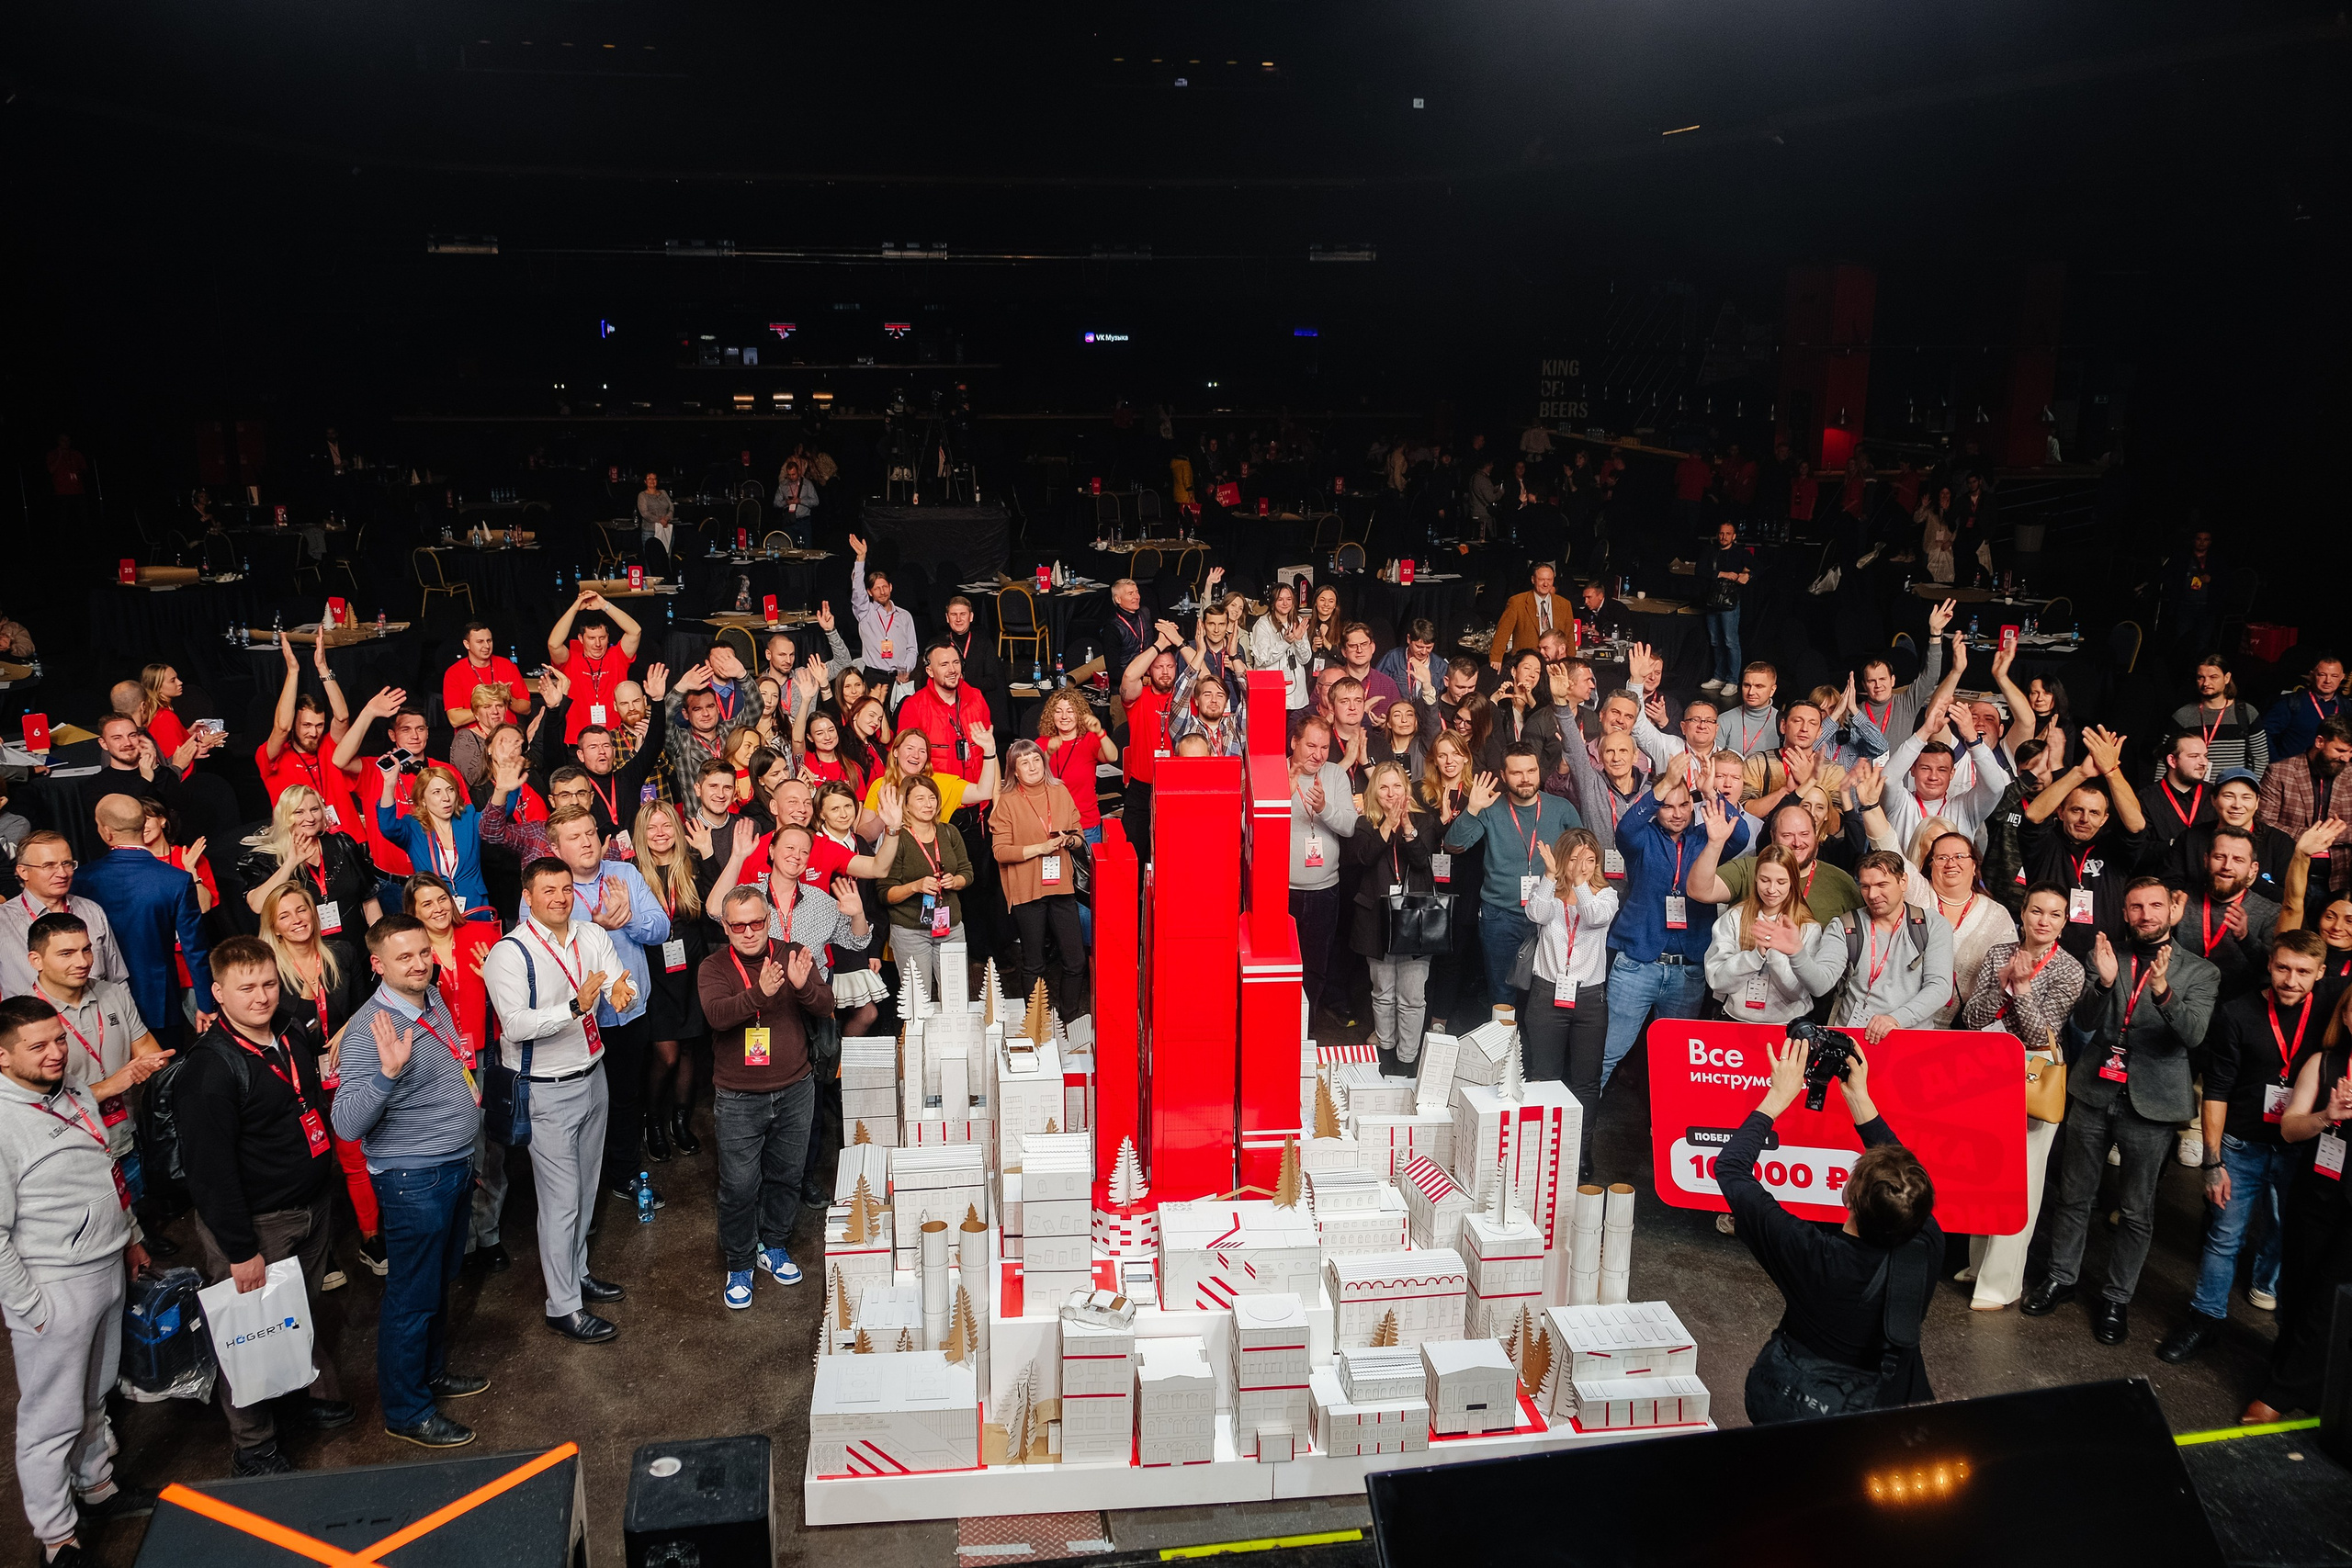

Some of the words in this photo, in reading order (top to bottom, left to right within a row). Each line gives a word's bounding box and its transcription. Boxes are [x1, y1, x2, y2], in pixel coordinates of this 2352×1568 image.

[1095, 333, 1105, 342] VK
[1105, 333, 1129, 343] Музыка
[1542, 359, 1579, 377] KING
[1539, 401, 1589, 418] BEERS
[33, 728, 40, 737] 6
[1689, 1038, 1744, 1067] Все
[1690, 1071, 1809, 1090] инструме
[226, 1321, 284, 1348] HÖGERT
